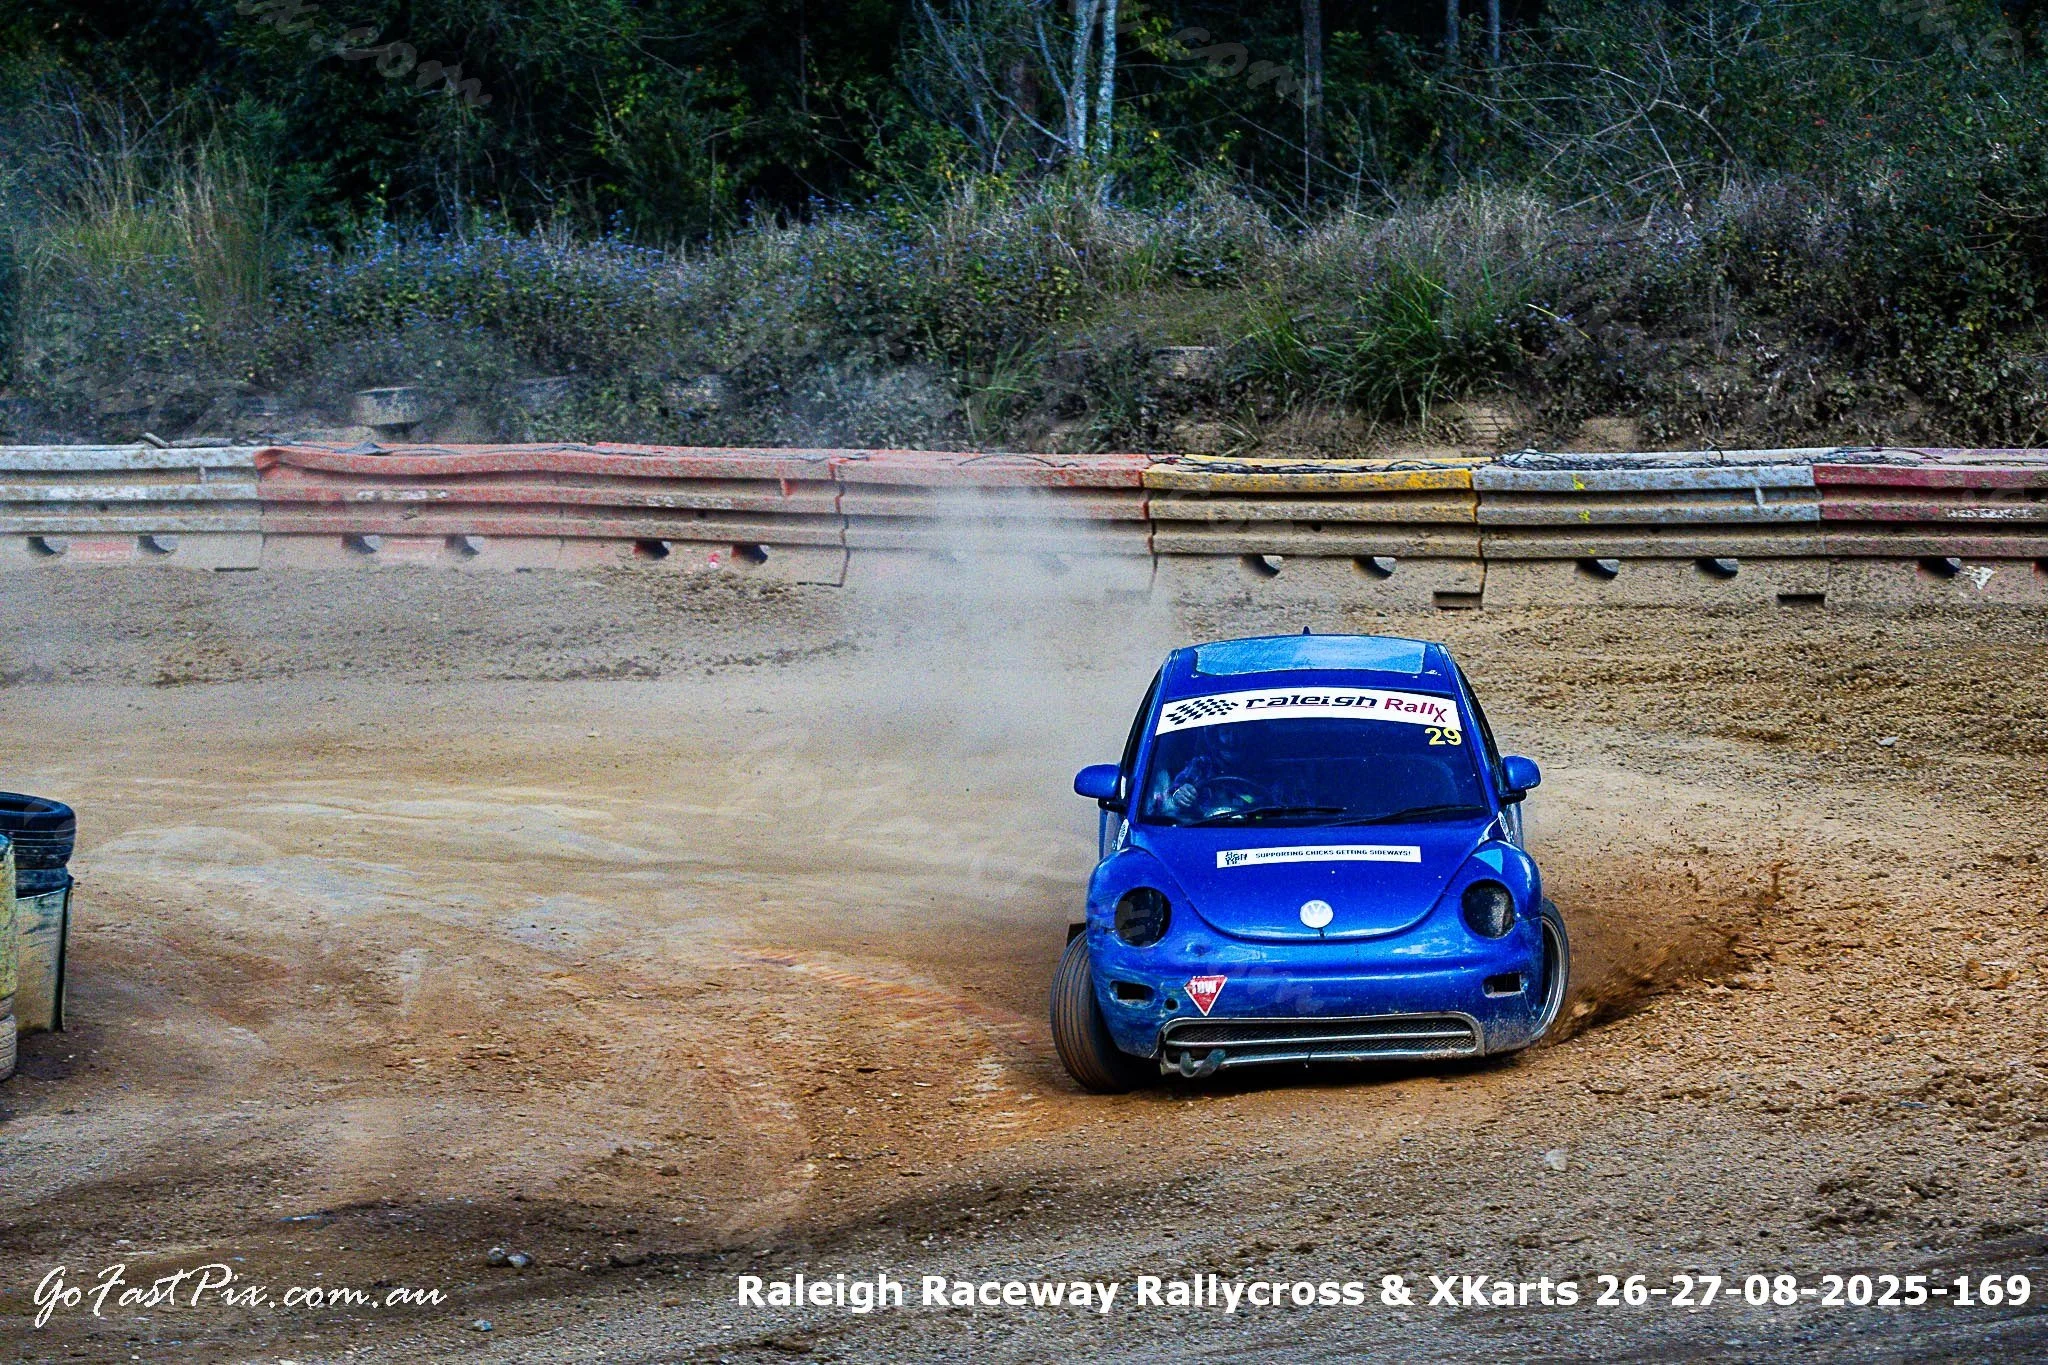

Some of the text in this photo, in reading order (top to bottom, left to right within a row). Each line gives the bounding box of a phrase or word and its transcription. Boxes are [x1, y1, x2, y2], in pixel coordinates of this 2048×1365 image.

[1245, 694, 1378, 709] raleigh
[1425, 727, 1462, 746] 29
[1255, 850, 1304, 859] SUPPORTING
[1190, 979, 1219, 995] TOW
